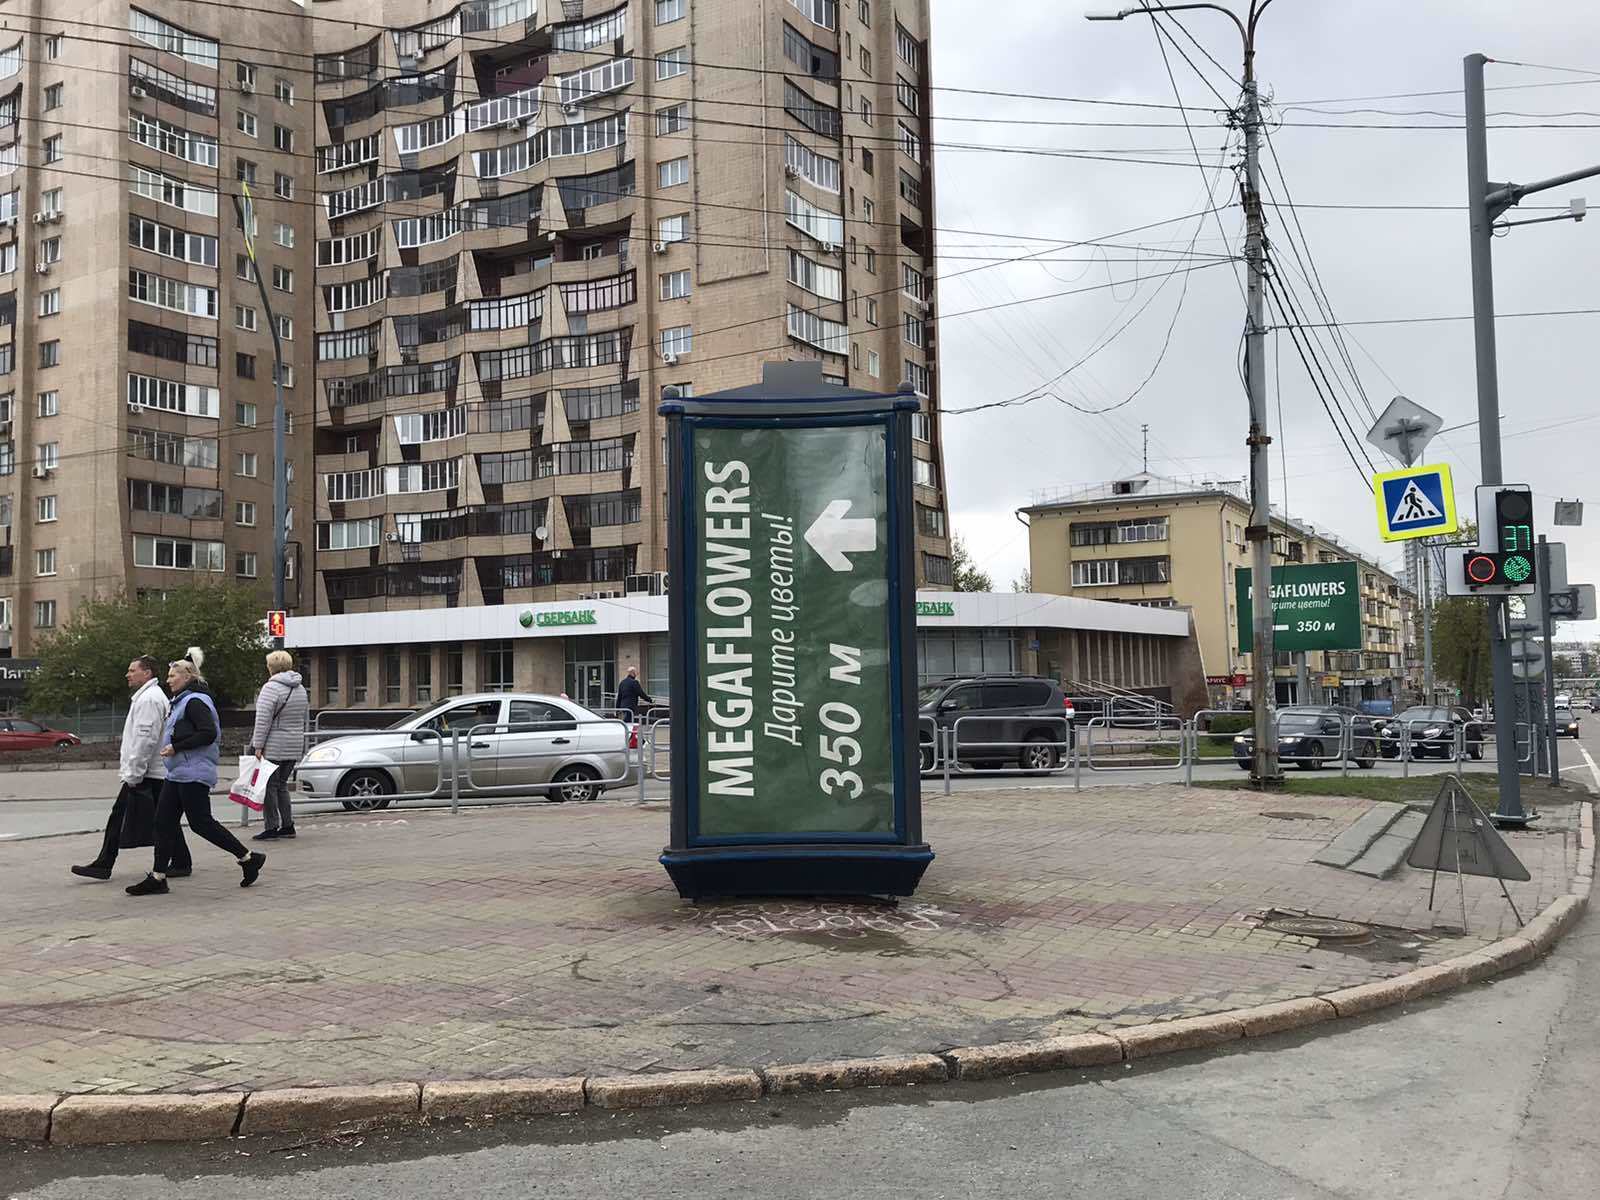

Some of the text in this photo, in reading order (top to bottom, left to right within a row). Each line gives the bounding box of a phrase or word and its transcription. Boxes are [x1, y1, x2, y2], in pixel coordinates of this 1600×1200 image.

[1504, 525, 1531, 551] 37
[1248, 581, 1346, 599] GAFLOWERS
[536, 610, 597, 627] СБЕРБАНК
[915, 601, 955, 616] РБАНК
[704, 460, 754, 797] MEGAFLOWERS
[761, 512, 805, 746] Дарите цветы!
[1296, 620, 1321, 632] 350
[818, 701, 863, 799] 350
